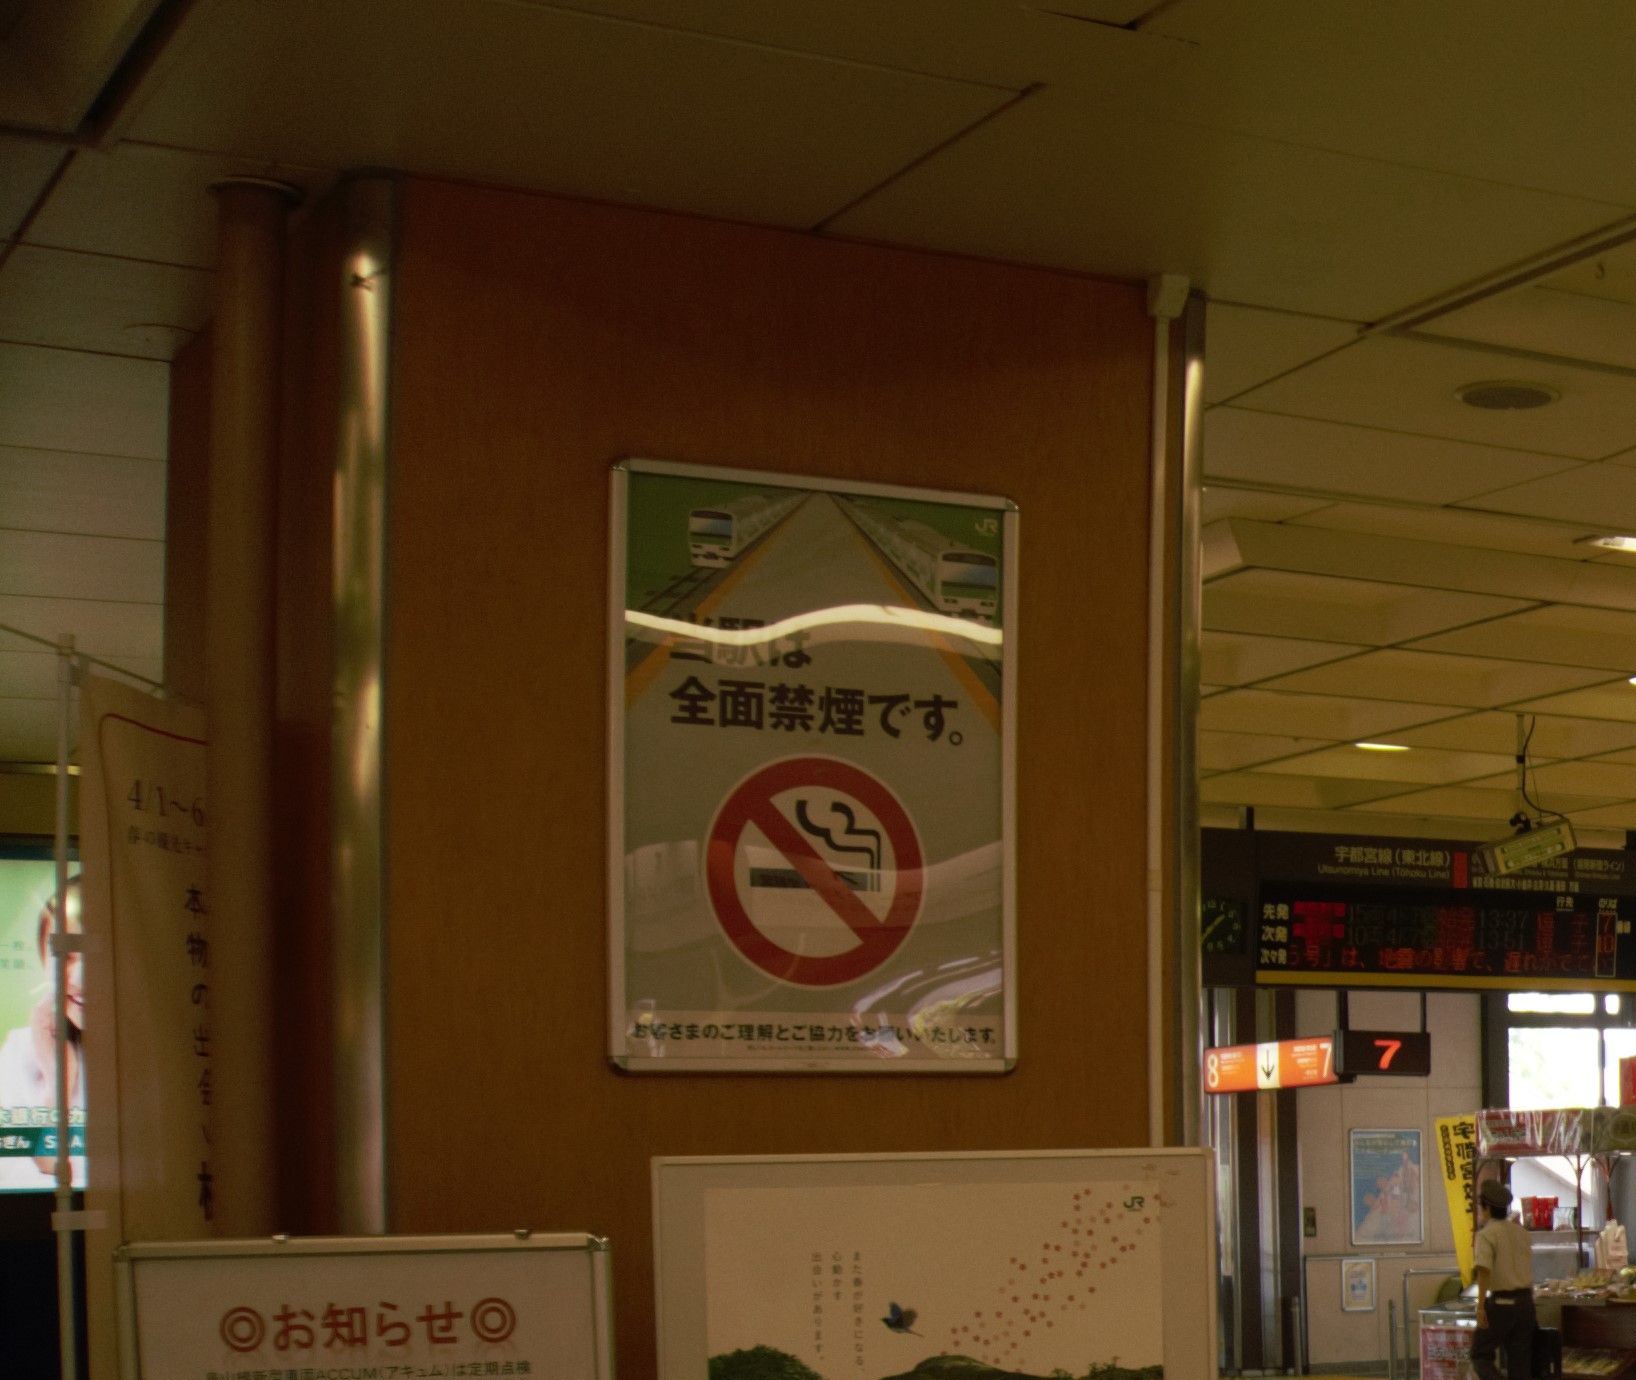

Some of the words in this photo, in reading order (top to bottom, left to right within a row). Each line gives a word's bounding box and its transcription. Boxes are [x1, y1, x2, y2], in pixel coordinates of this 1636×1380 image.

[974, 518, 998, 534] JR
[668, 676, 963, 745] 全面禁煙です。
[1370, 866, 1390, 876] Line
[1263, 903, 1289, 920] 先発
[1261, 924, 1288, 943] 次発
[1319, 1042, 1331, 1078] 7
[1374, 1039, 1402, 1070] 7
[1207, 1053, 1219, 1088] 8
[1123, 1195, 1144, 1209] JR
